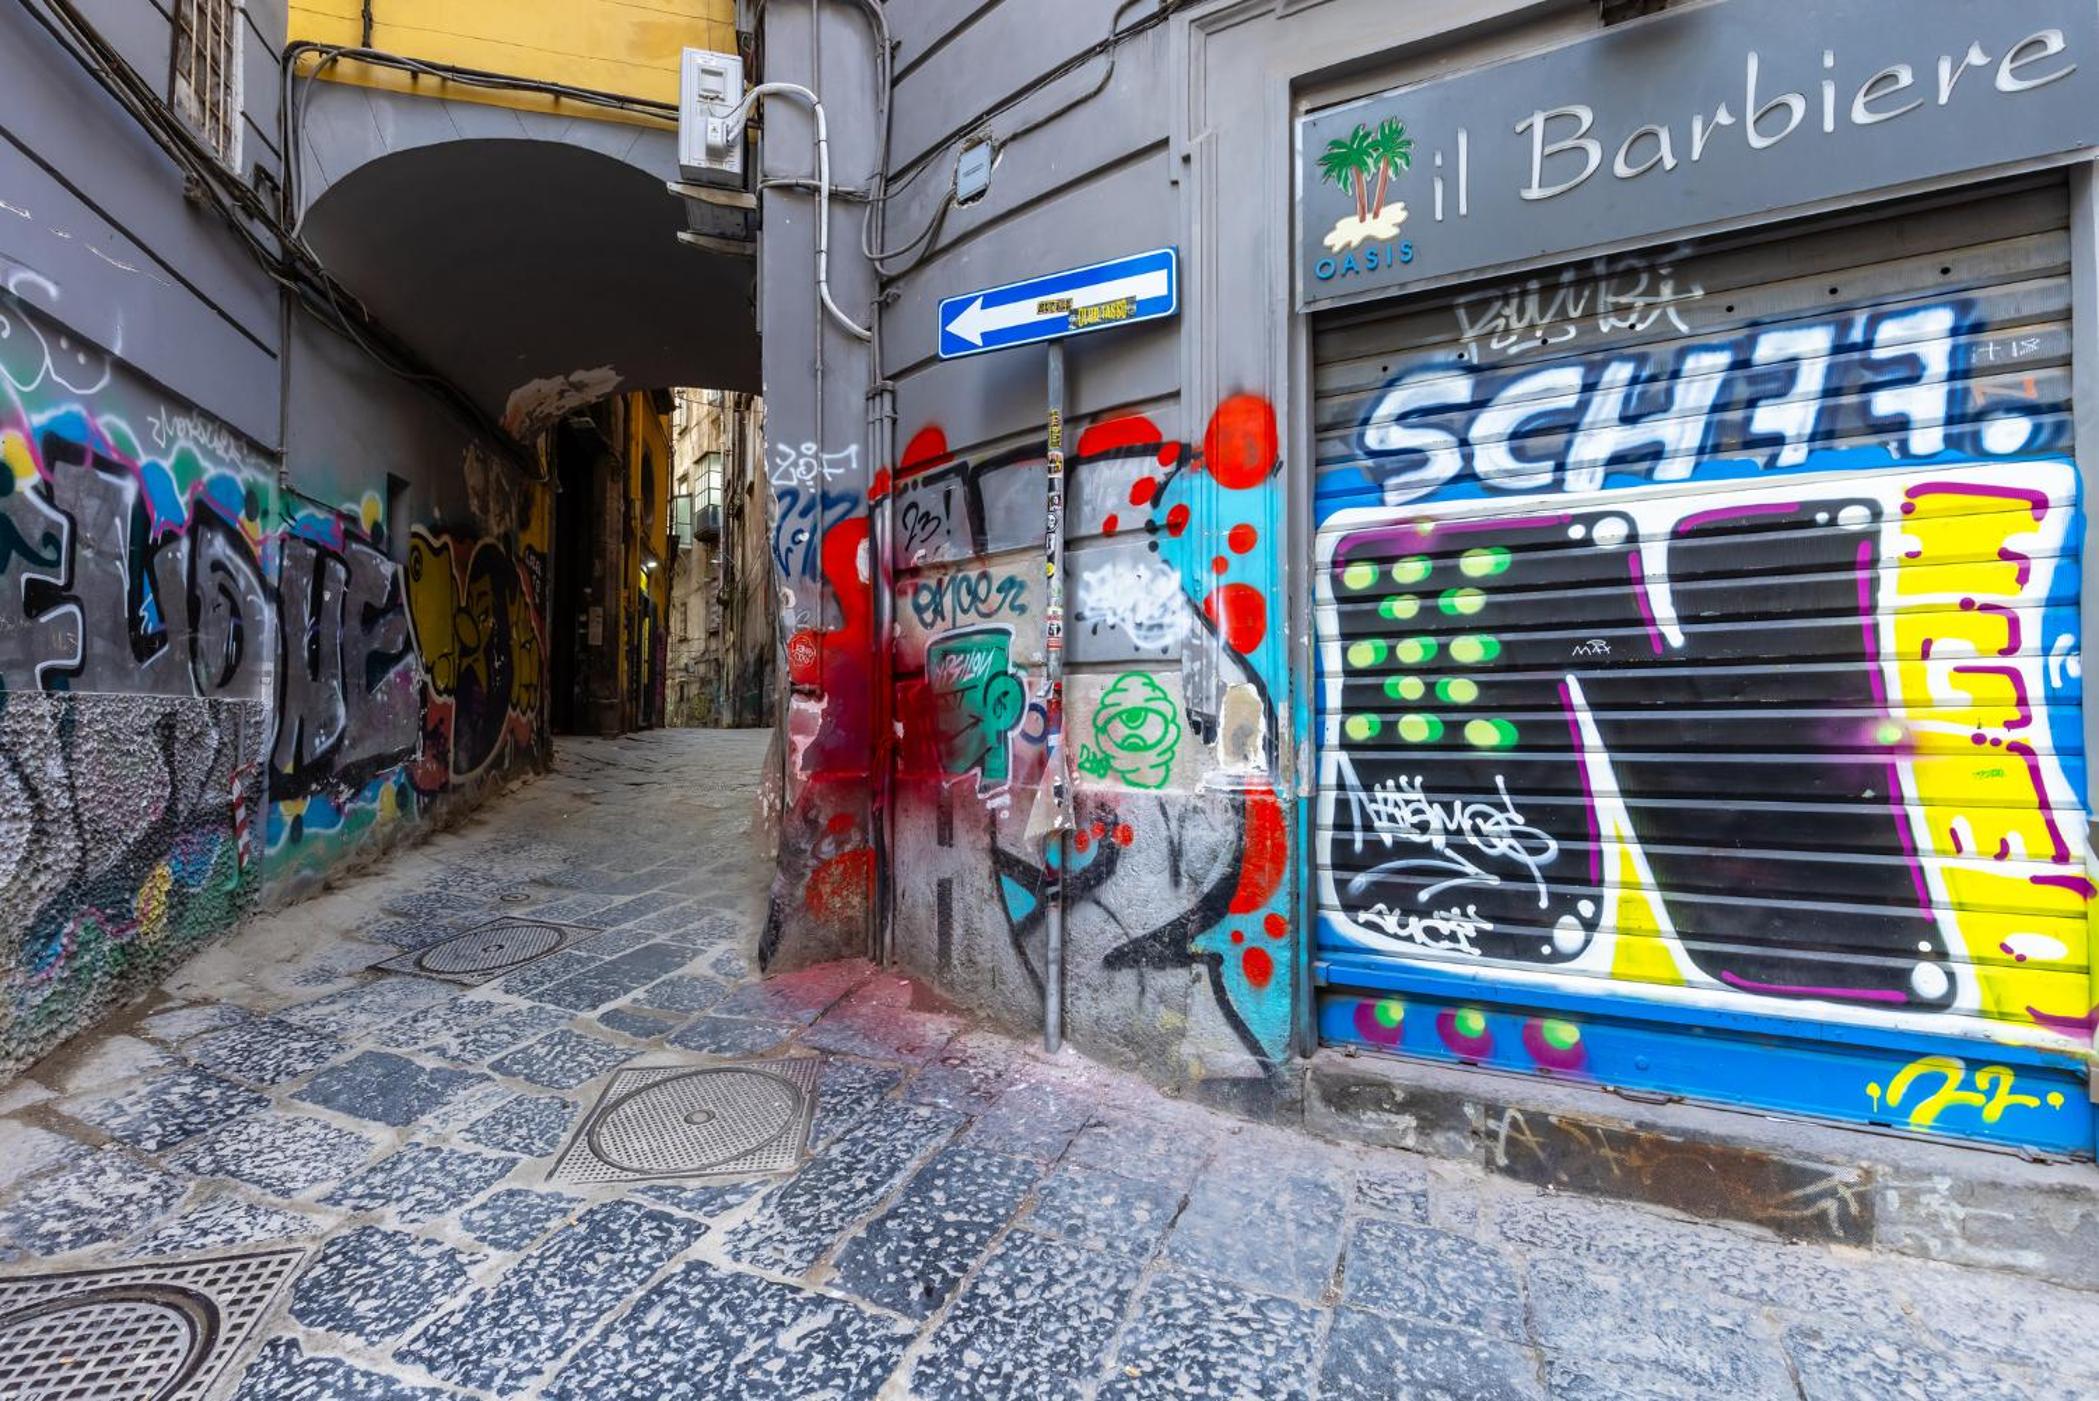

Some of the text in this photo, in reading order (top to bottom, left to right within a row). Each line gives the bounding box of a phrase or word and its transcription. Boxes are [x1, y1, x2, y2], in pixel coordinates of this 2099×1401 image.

[1433, 27, 2078, 223] il Barbiere
[1315, 239, 1414, 280] OASIS
